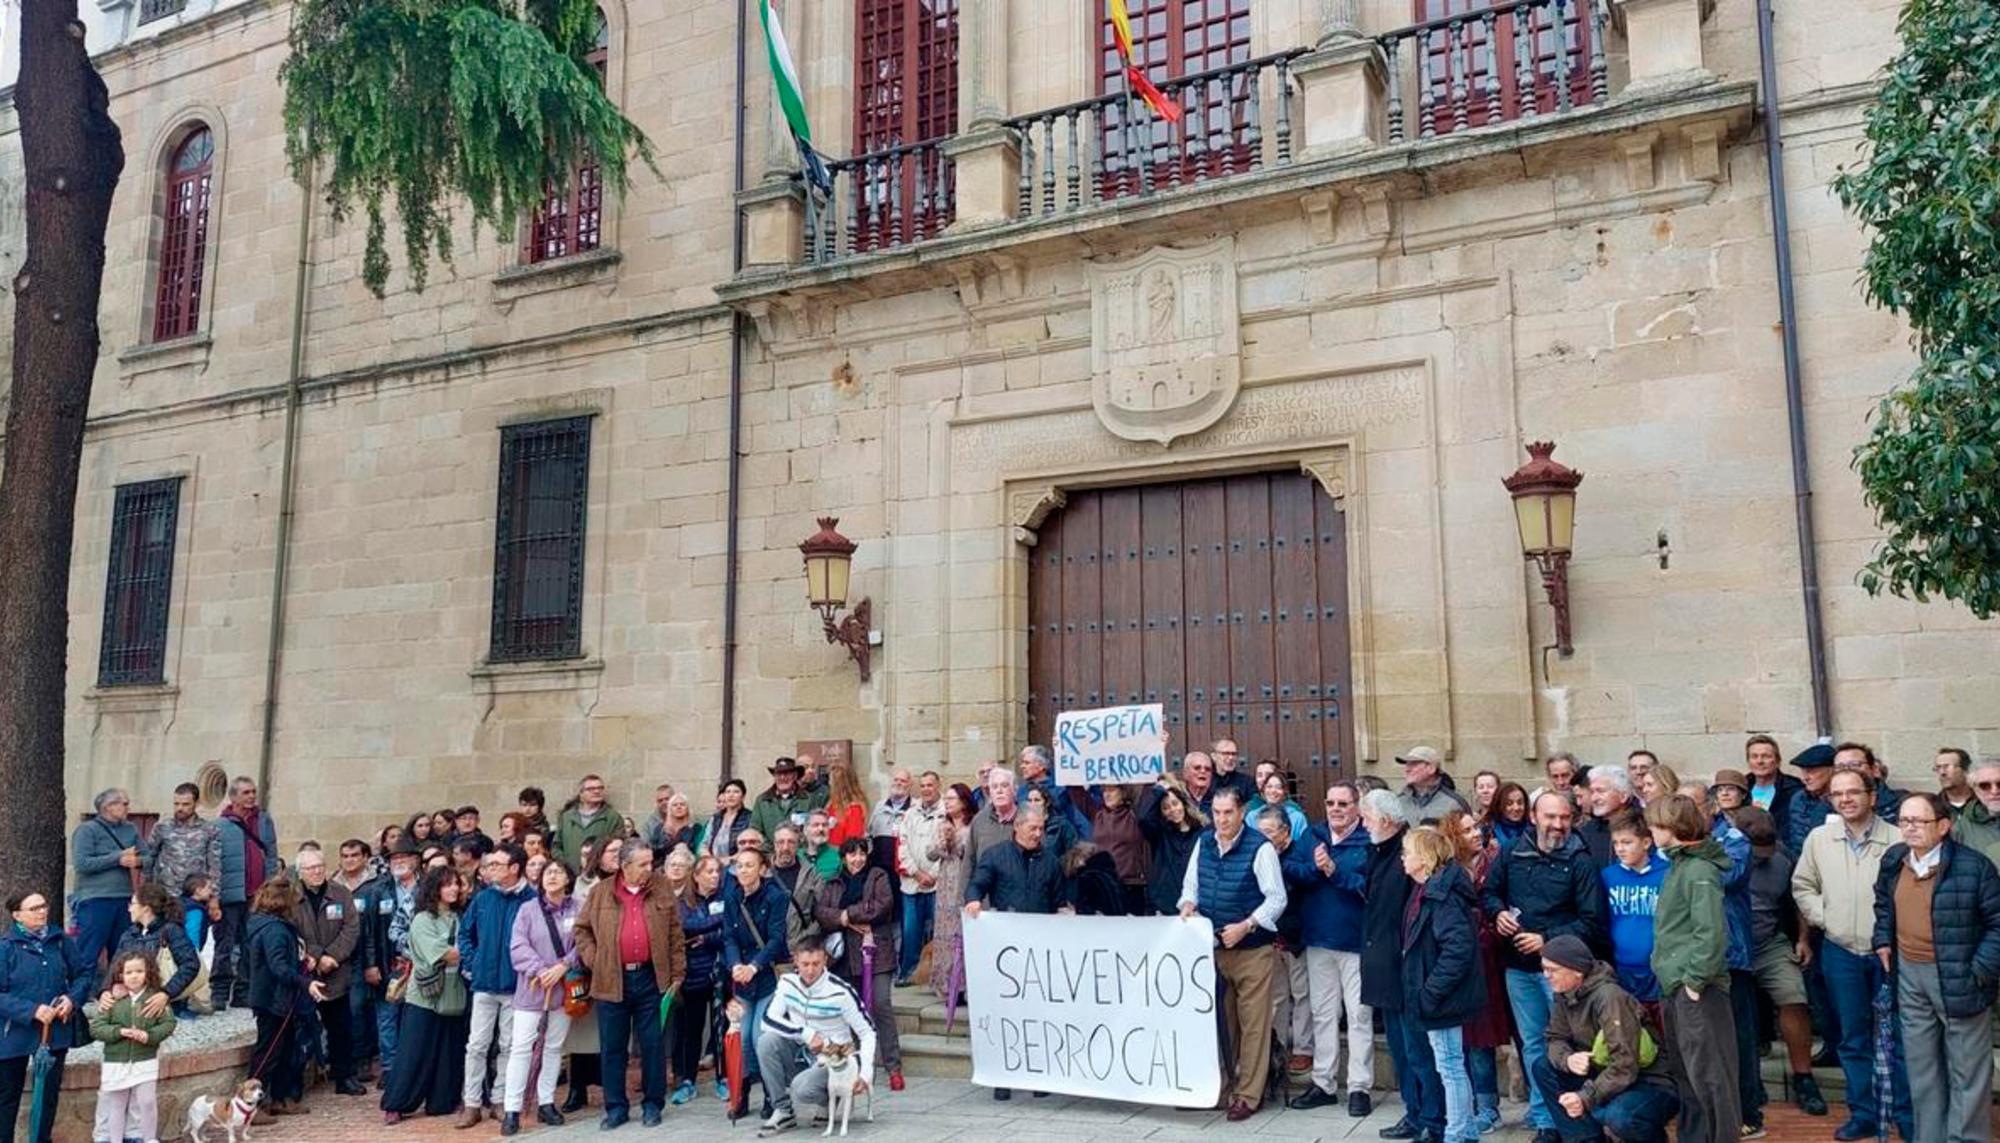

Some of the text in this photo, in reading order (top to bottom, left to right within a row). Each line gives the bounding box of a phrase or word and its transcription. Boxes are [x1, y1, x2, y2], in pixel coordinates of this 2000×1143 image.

[1060, 708, 1156, 755] RESPETA
[1060, 755, 1079, 769] EL
[996, 946, 1213, 1013] SALVEMOS
[1001, 1017, 1193, 1092] BERROCAL
